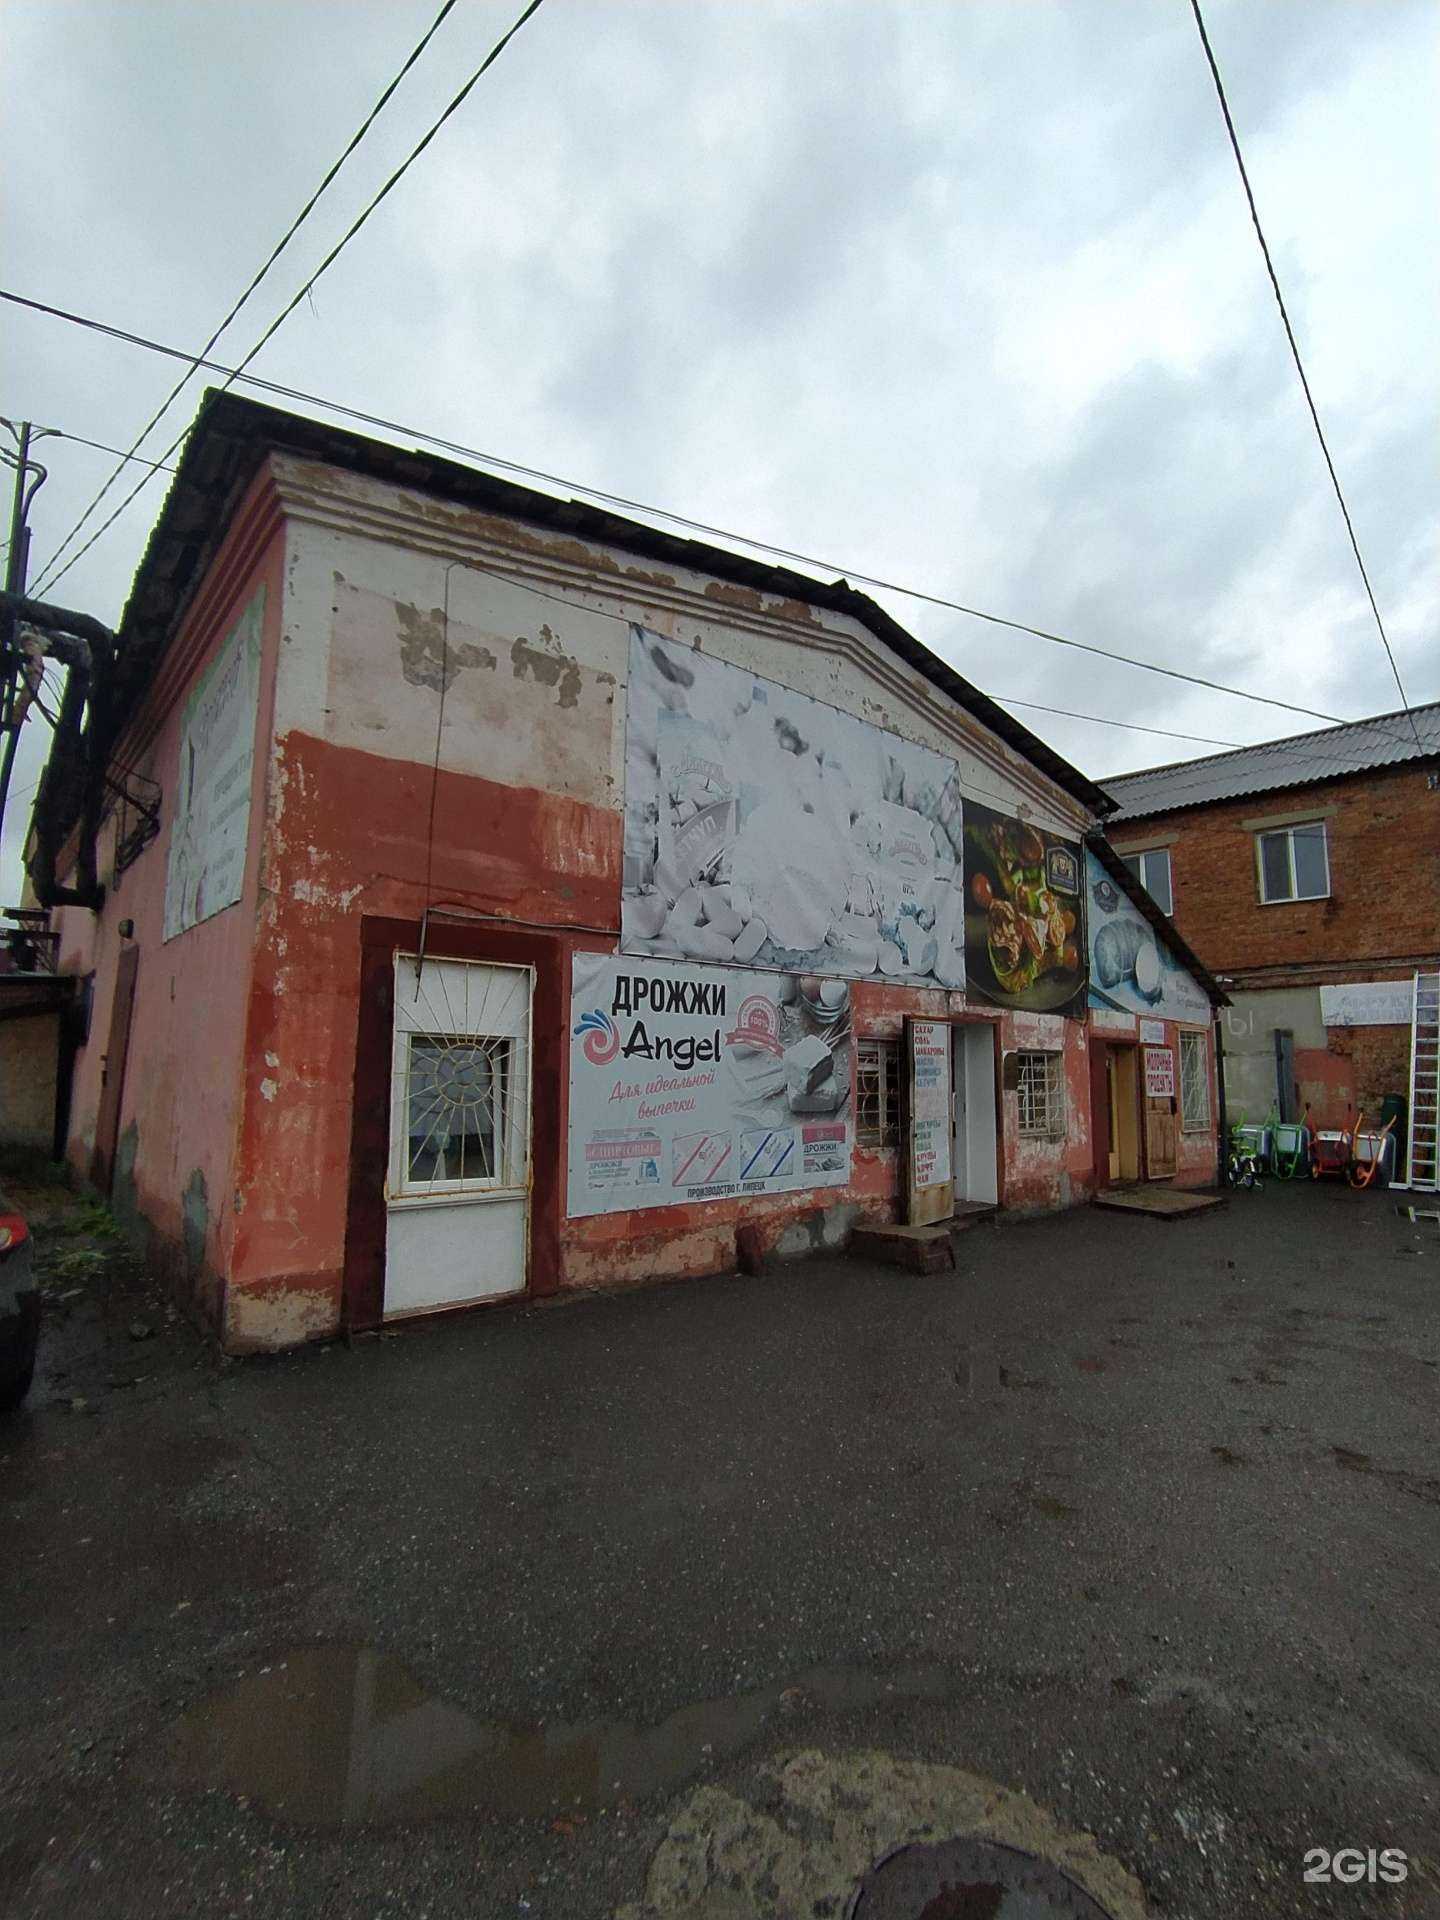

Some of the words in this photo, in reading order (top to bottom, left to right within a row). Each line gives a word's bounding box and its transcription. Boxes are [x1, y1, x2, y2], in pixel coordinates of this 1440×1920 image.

[611, 975, 726, 1017] ДРОЖЖИ
[914, 1025, 934, 1034] САХАР
[621, 1020, 721, 1070] Angel
[608, 1081, 642, 1104] Для
[646, 1069, 716, 1094] идеальной
[638, 1098, 696, 1119] выпечки
[804, 1143, 836, 1153] ДРОЖЖИ
[688, 1184, 735, 1198] ПРОИЗВОДСТВО
